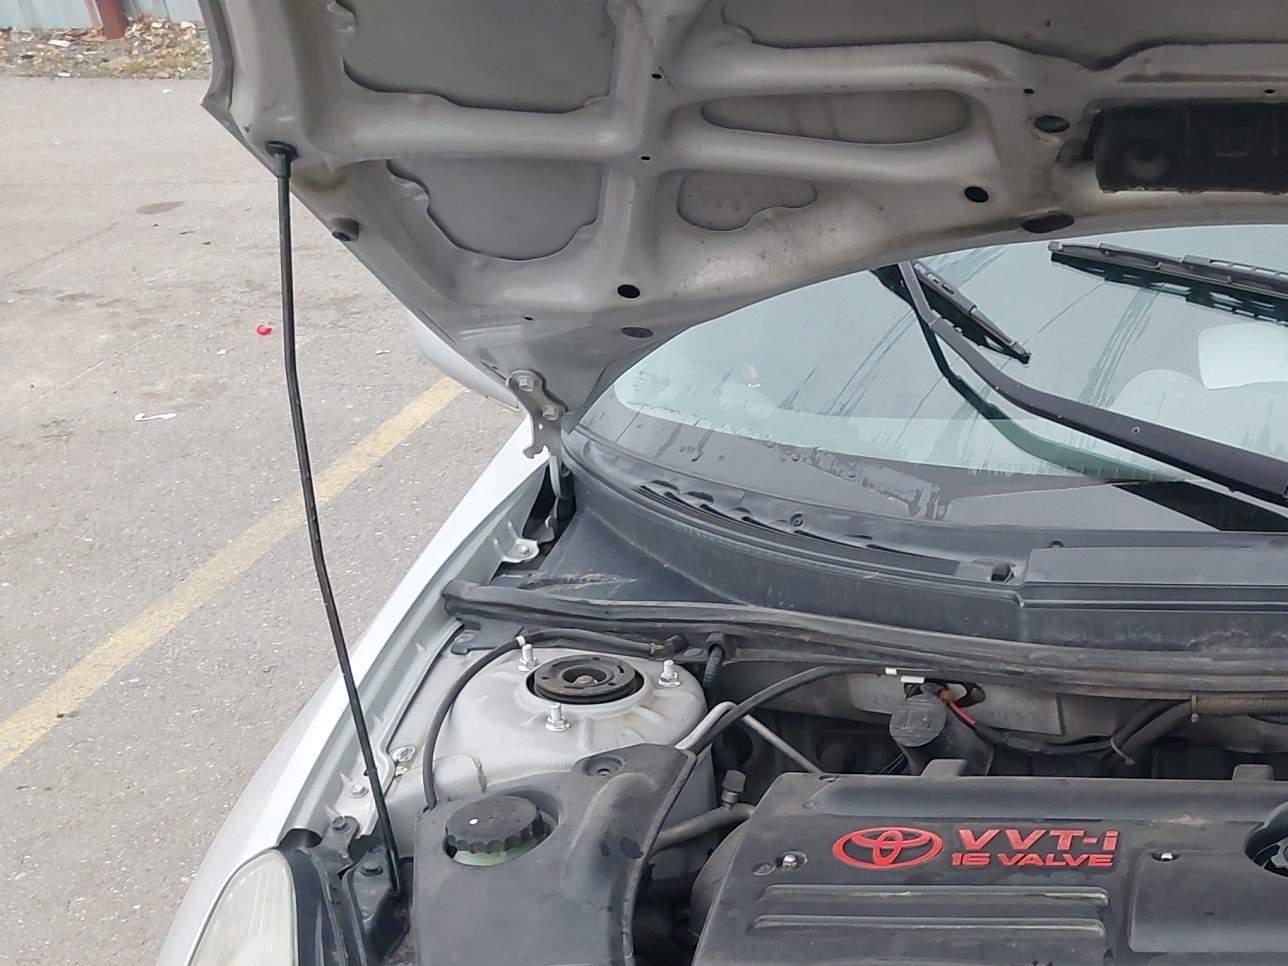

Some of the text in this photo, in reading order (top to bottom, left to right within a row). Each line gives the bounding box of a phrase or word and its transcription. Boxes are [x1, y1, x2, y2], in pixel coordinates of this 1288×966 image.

[959, 829, 1120, 850] VVT-i
[952, 852, 1115, 867] 16 VALVE
